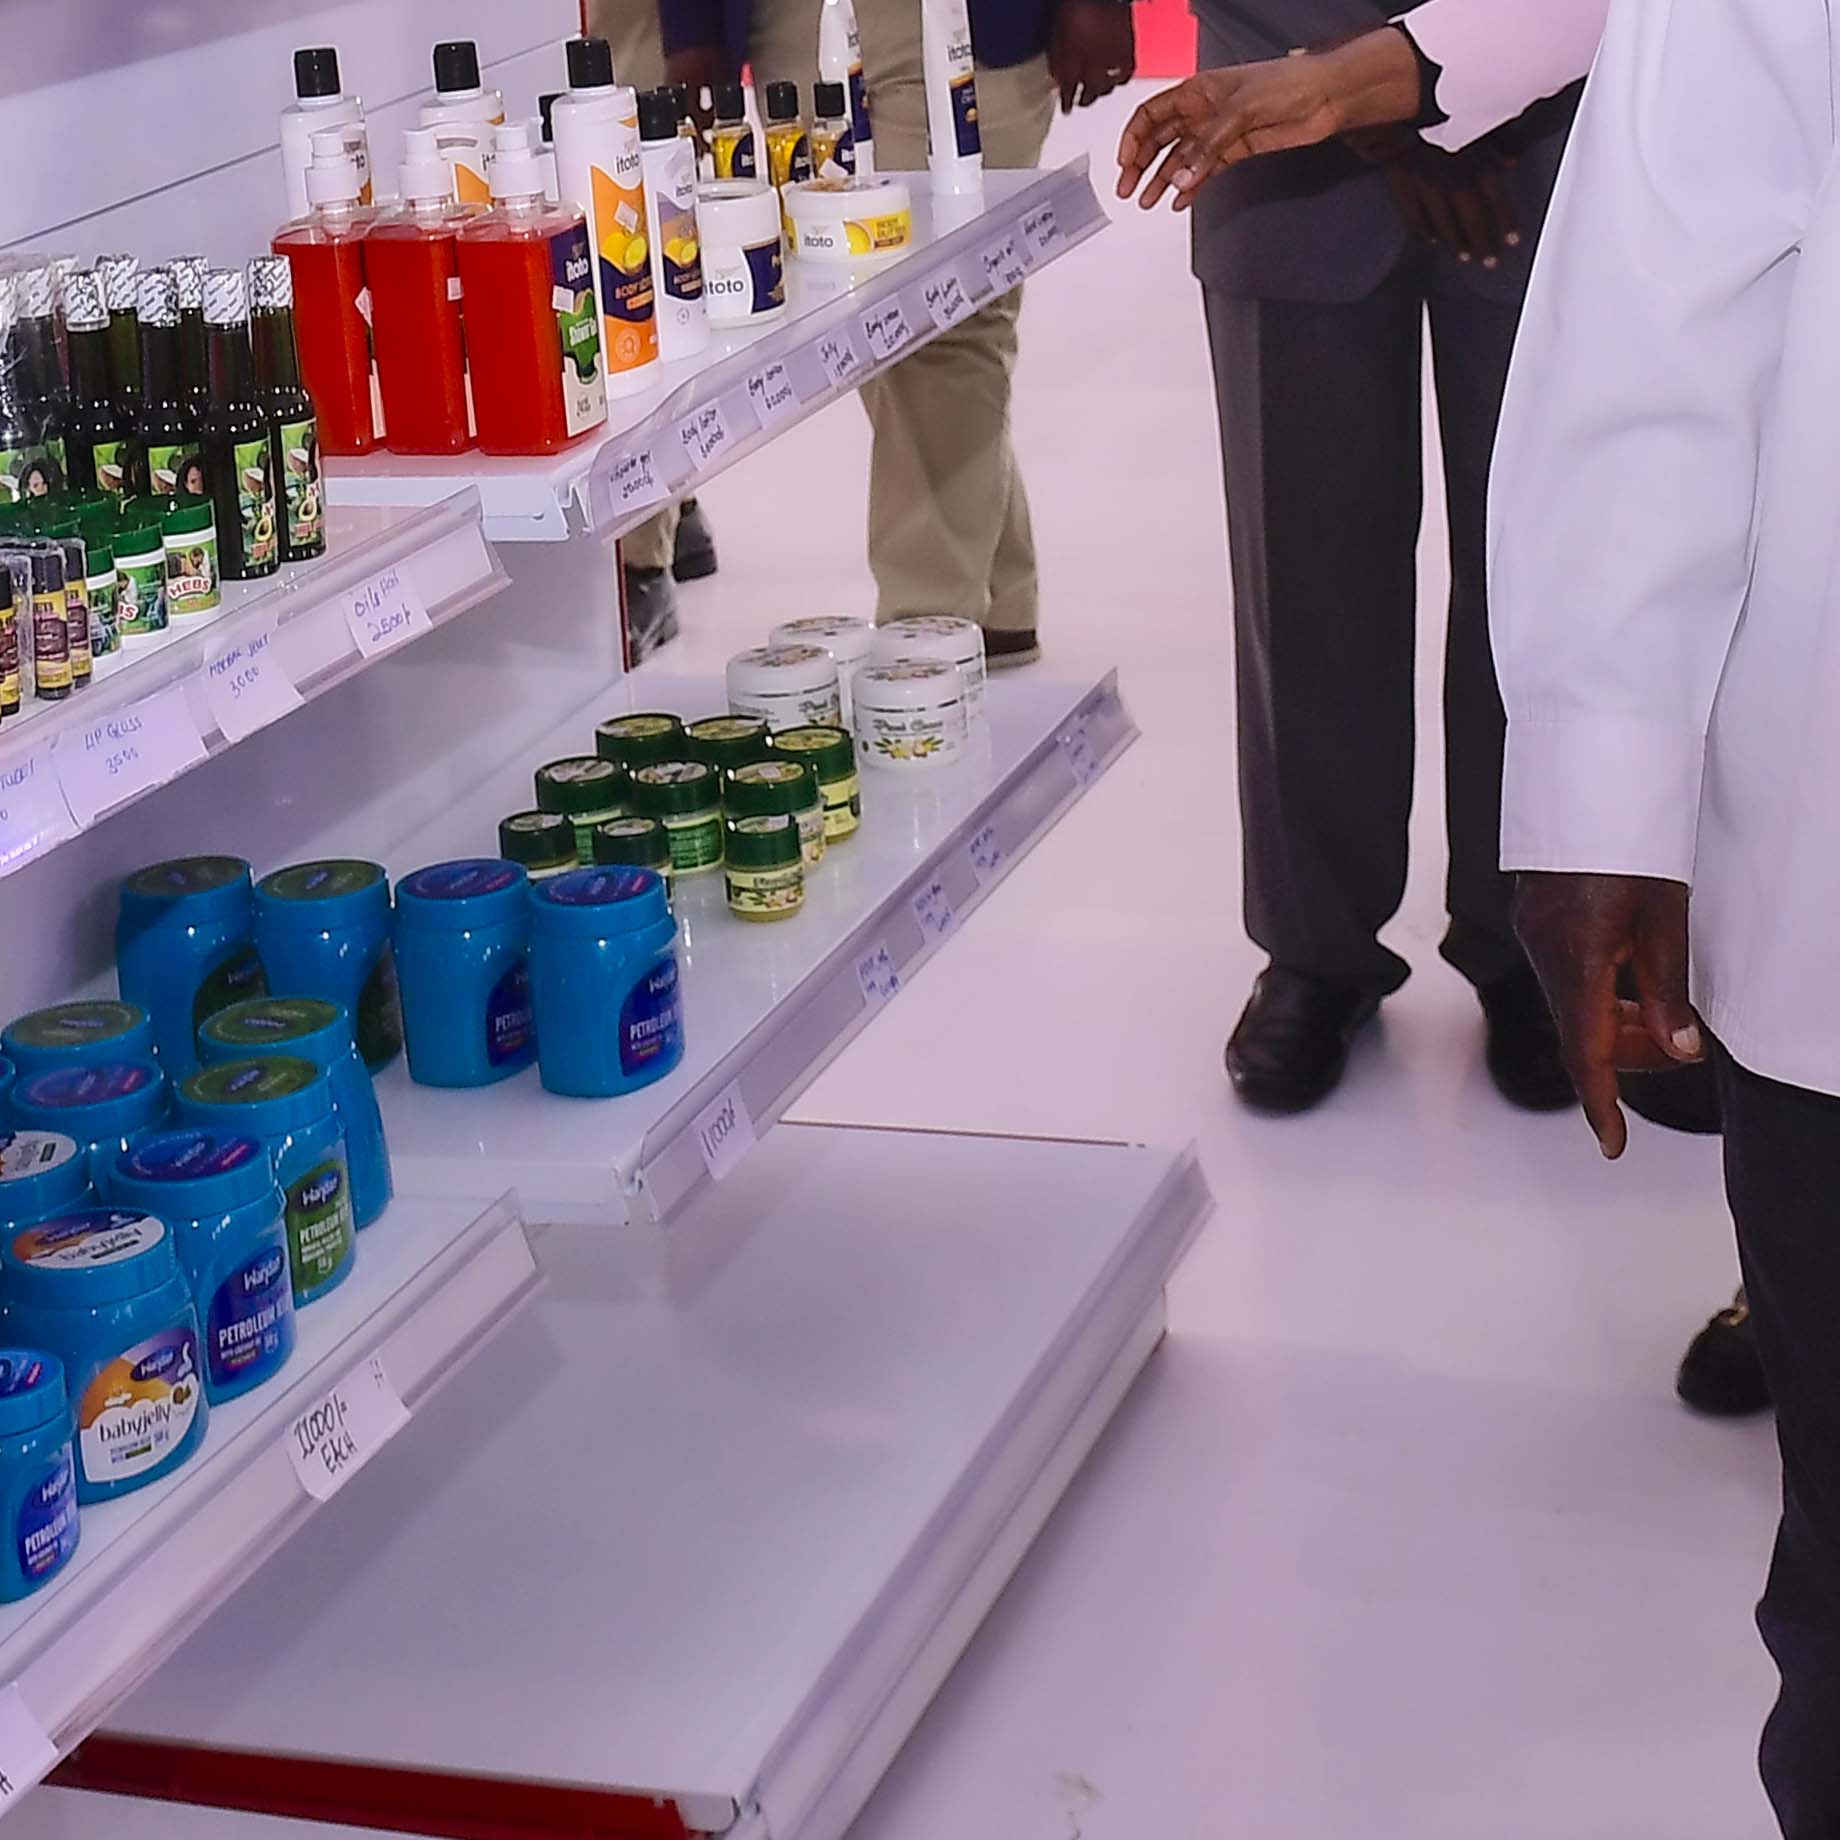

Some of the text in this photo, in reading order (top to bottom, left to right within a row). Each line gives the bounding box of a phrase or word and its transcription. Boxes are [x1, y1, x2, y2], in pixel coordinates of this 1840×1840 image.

[803, 234, 834, 248] itoto
[167, 577, 211, 600] HEBS
[99, 1402, 172, 1442] babyjelly
[321, 1429, 359, 1474] EACH
